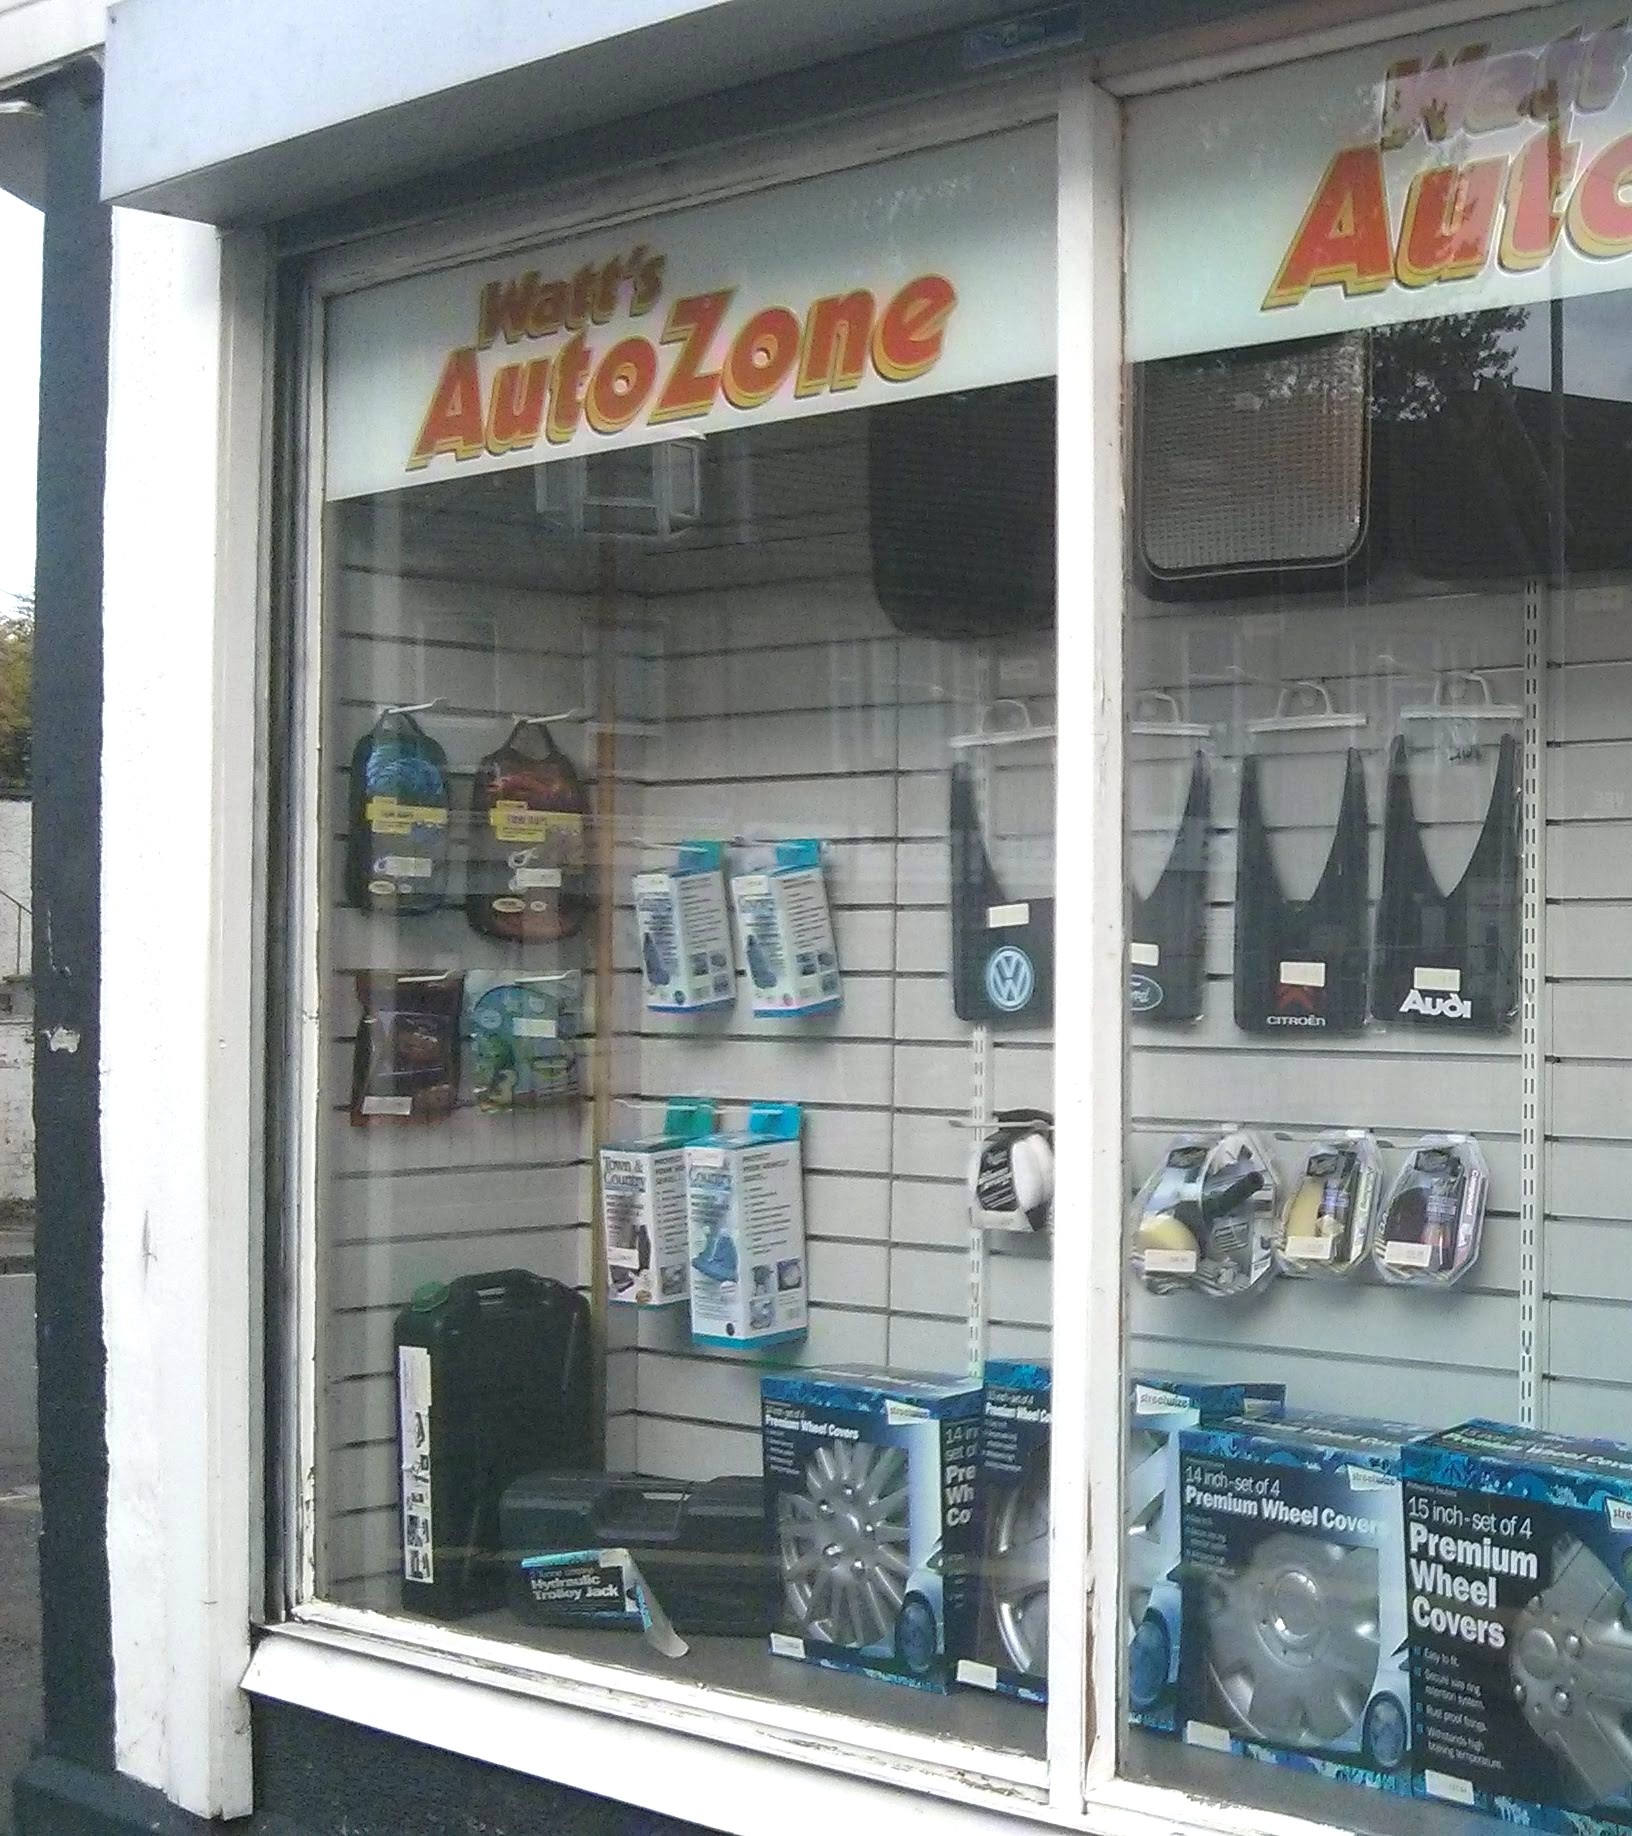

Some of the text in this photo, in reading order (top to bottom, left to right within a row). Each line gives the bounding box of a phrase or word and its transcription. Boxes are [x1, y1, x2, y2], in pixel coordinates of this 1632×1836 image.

[477, 243, 668, 350] Watt's
[406, 272, 959, 472] AutoZone
[1400, 989, 1472, 1018] Audi
[603, 1156, 632, 1172] Town
[604, 1172, 647, 1192] Country
[1186, 1466, 1202, 1485] 14
[1255, 1479, 1270, 1495] of
[1270, 1479, 1281, 1497] 4
[1186, 1485, 1258, 1515] Premium
[1262, 1498, 1319, 1527] Wheel
[1408, 1496, 1430, 1519] 15
[1500, 1515, 1519, 1538] of
[1519, 1517, 1533, 1539] 4
[1409, 1521, 1538, 1579] Premium
[531, 1574, 601, 1591] Hydraulic
[532, 1584, 619, 1600] Trolley Jack
[1410, 1557, 1497, 1609] Wheel
[1412, 1595, 1505, 1648] Covers
